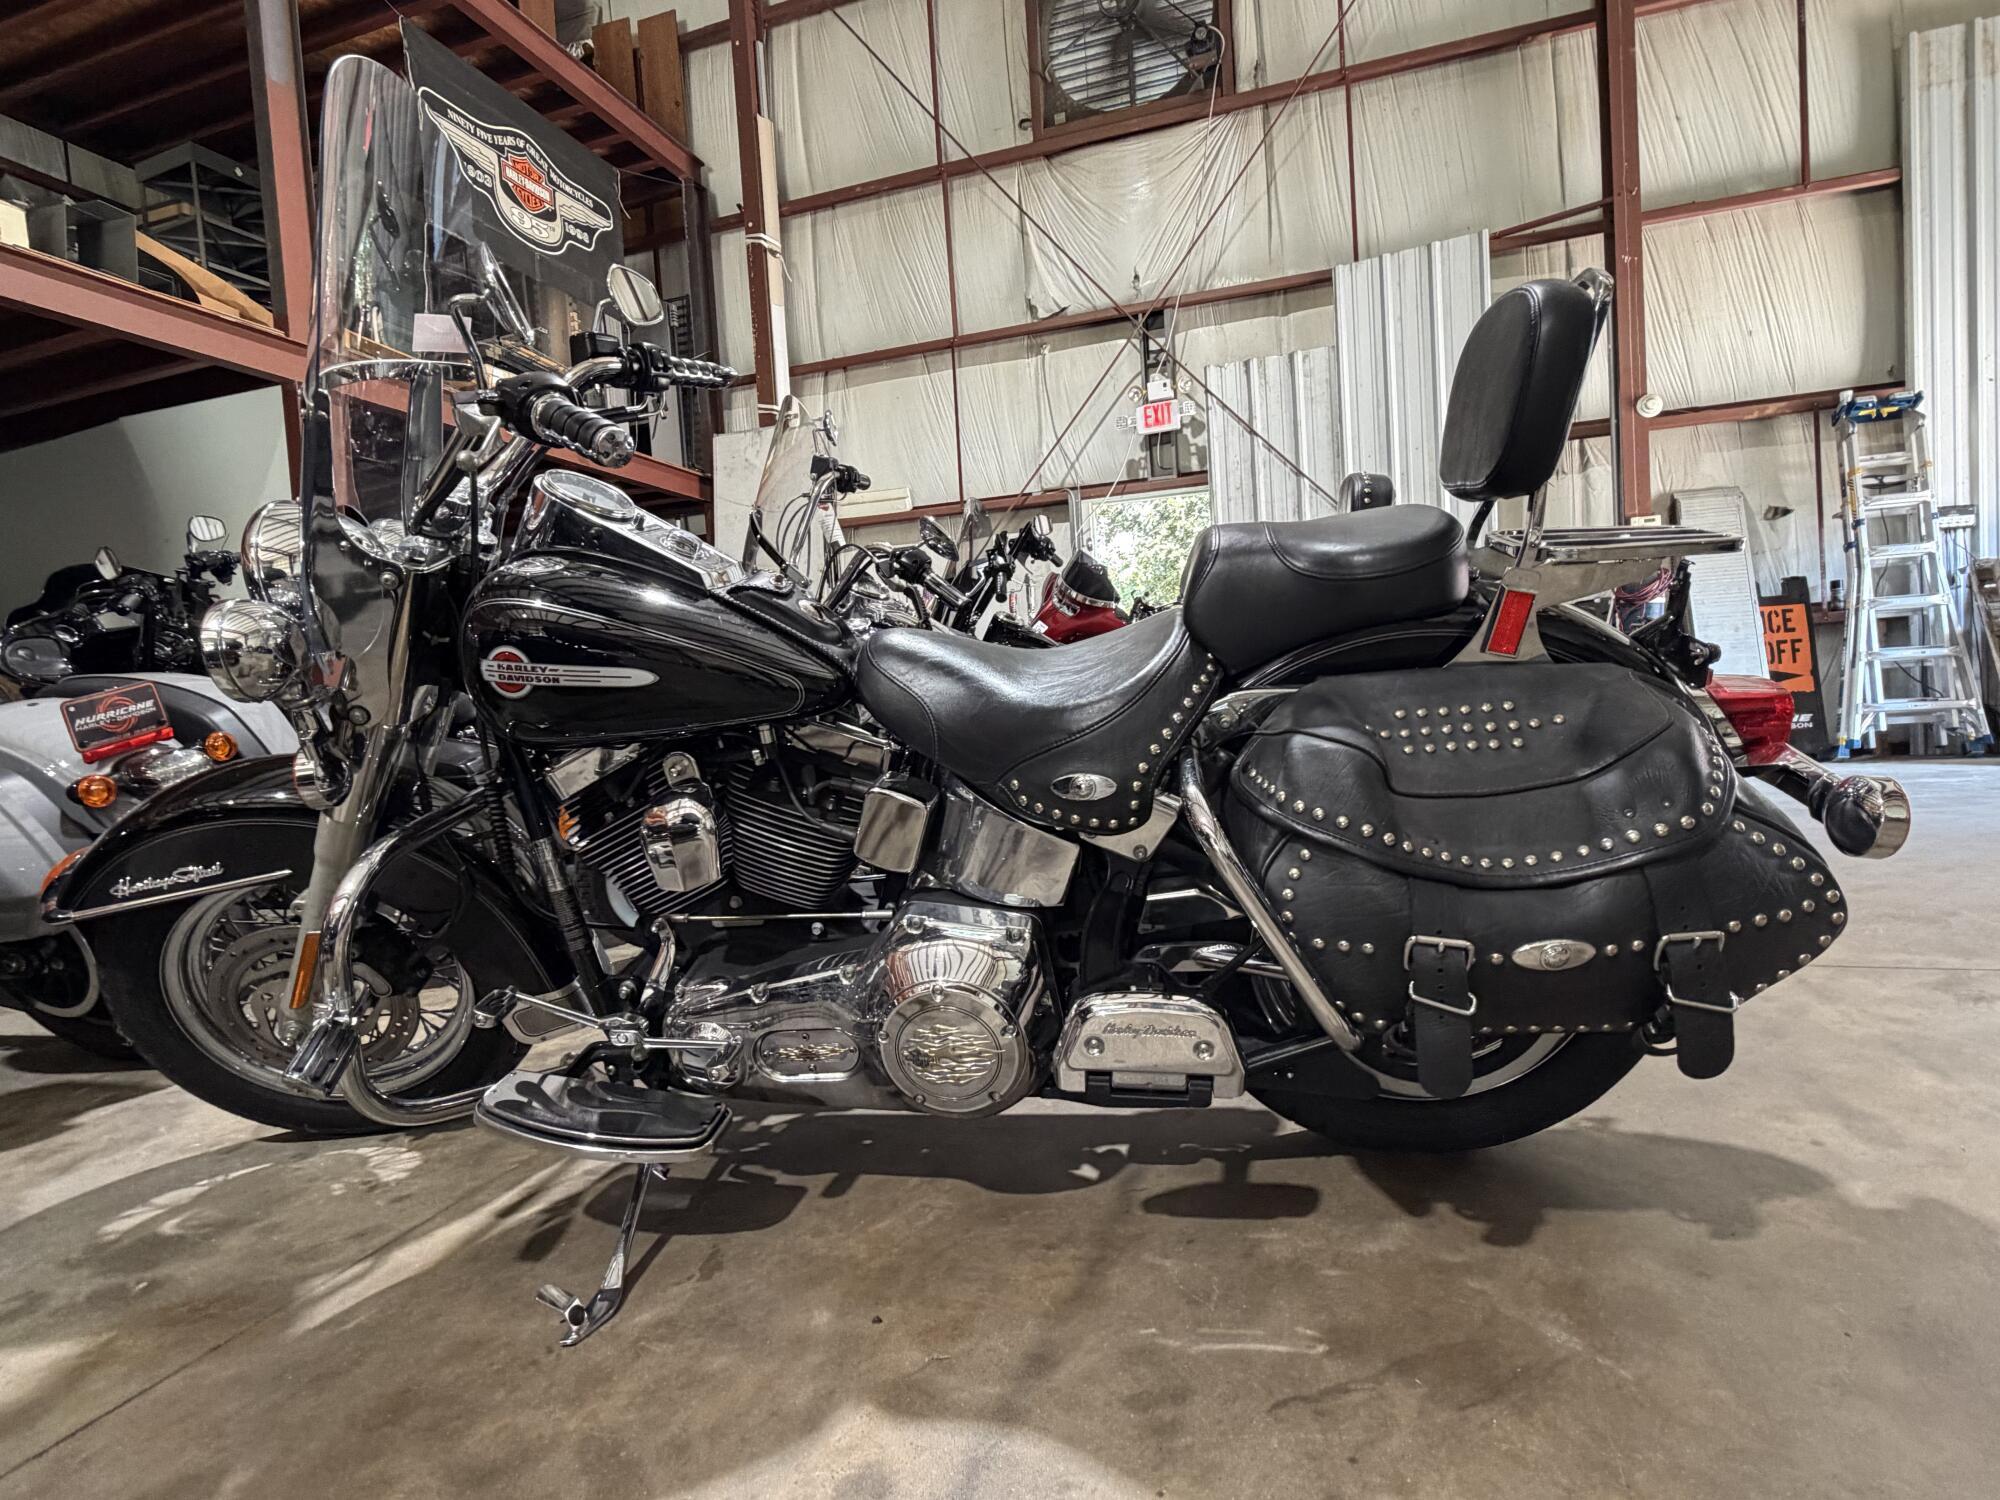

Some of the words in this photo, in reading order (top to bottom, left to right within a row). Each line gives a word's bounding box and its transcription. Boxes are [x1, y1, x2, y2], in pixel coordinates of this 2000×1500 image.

[447, 108, 475, 134] NINETY
[476, 127, 493, 144] FIVE
[493, 134, 516, 147] YEARS
[515, 137, 526, 149] OF
[526, 143, 548, 172] GREAT
[549, 168, 594, 208] MOTORCYCLES
[1143, 403, 1172, 429] EXIT
[498, 673, 560, 684] DAVIDSON
[75, 698, 155, 728] HURRICANE
